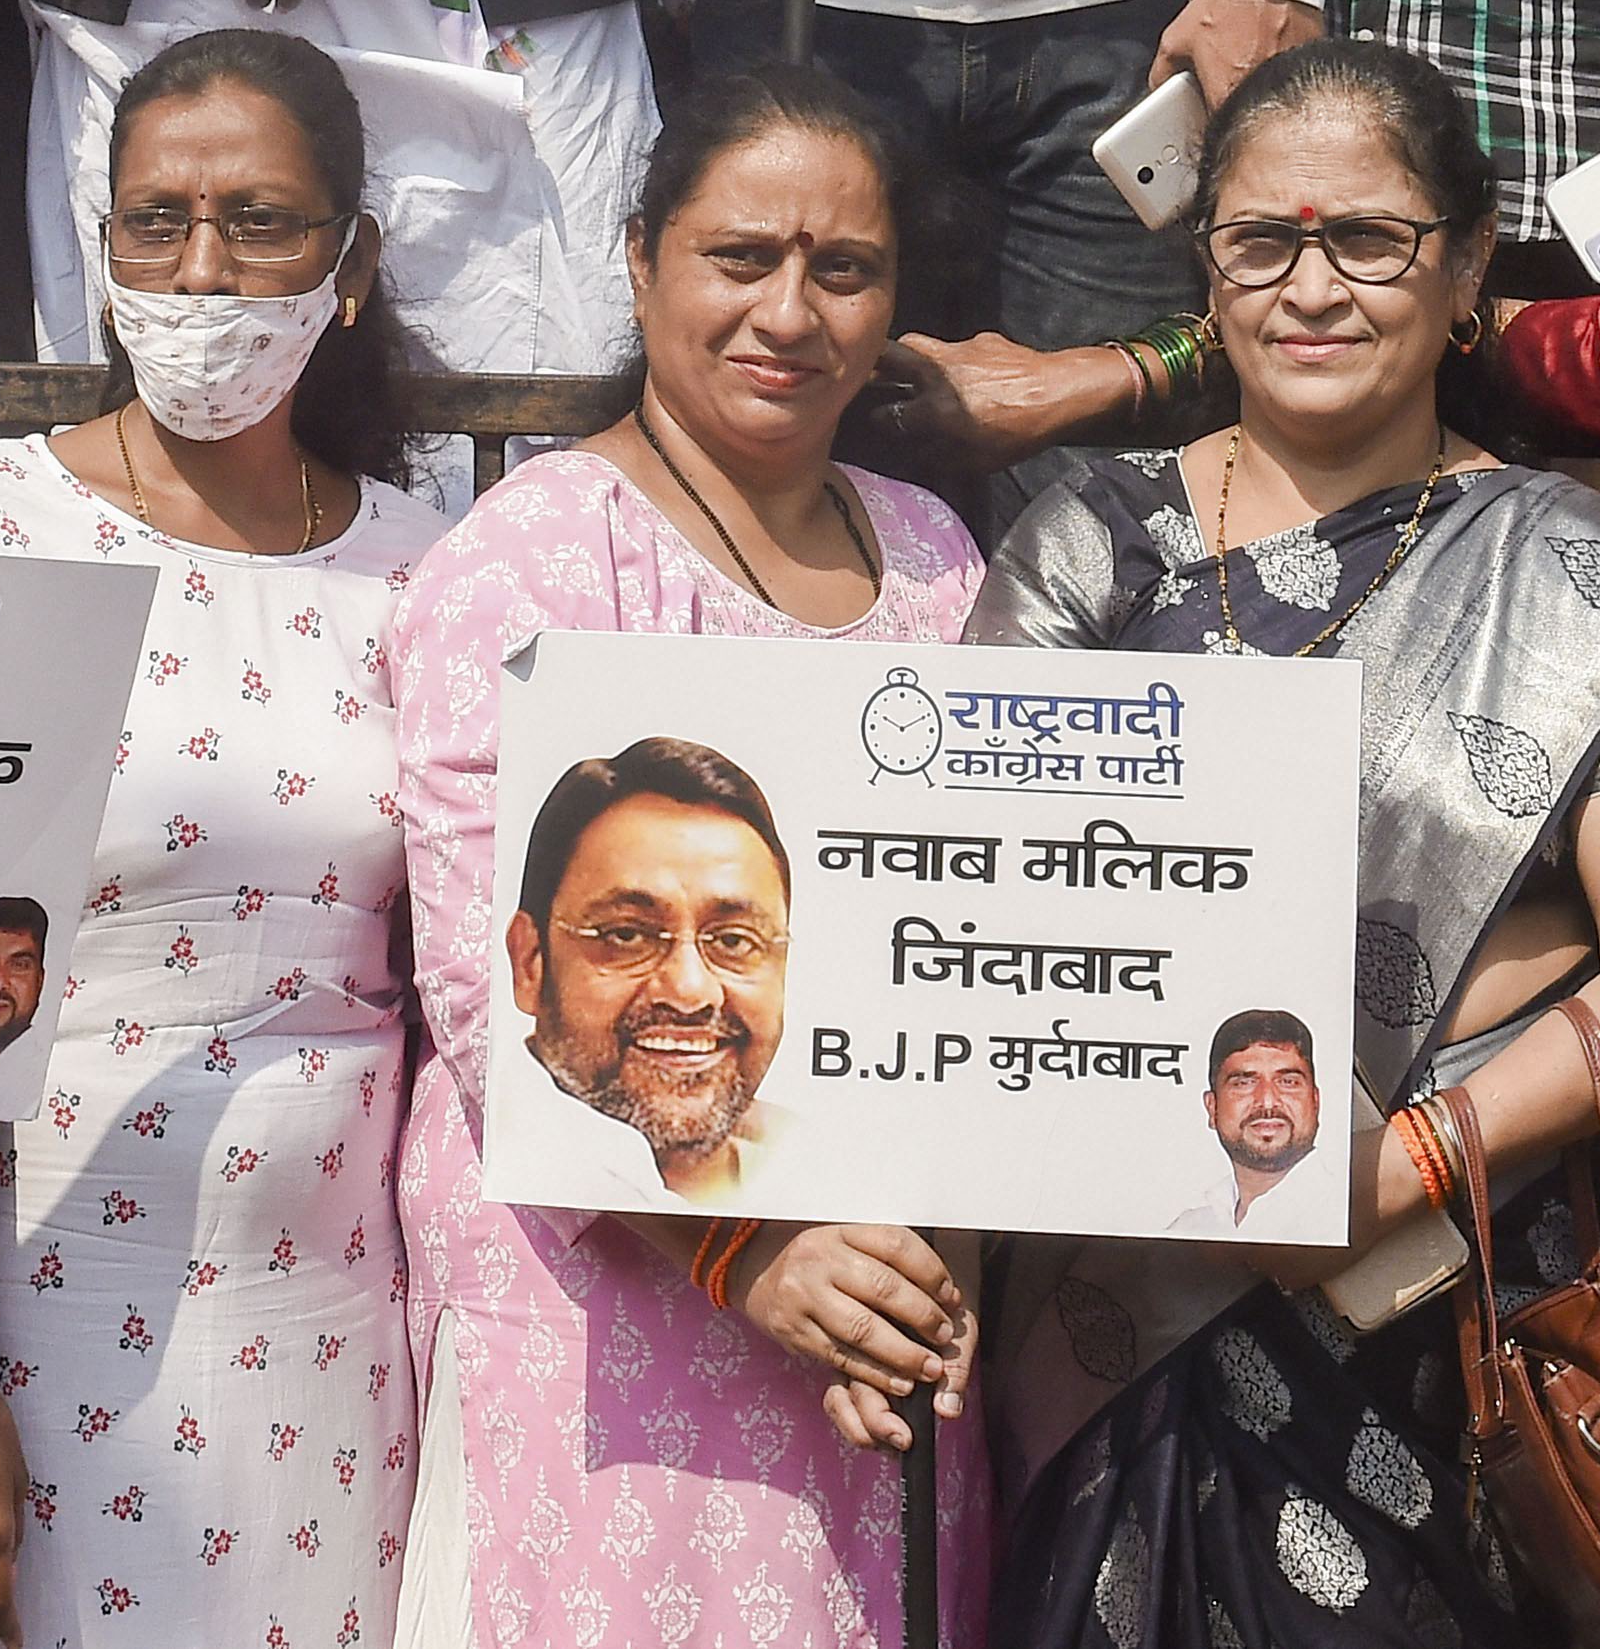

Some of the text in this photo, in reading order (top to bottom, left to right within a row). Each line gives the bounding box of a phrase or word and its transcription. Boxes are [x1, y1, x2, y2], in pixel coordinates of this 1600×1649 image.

[1097, 745, 1184, 785] पार्टी
[818, 820, 1252, 893] नवाब मलिक
[892, 917, 1172, 1001] जिंदाबाद
[812, 1019, 1189, 1091] B.J.P मुर्दाबाद
